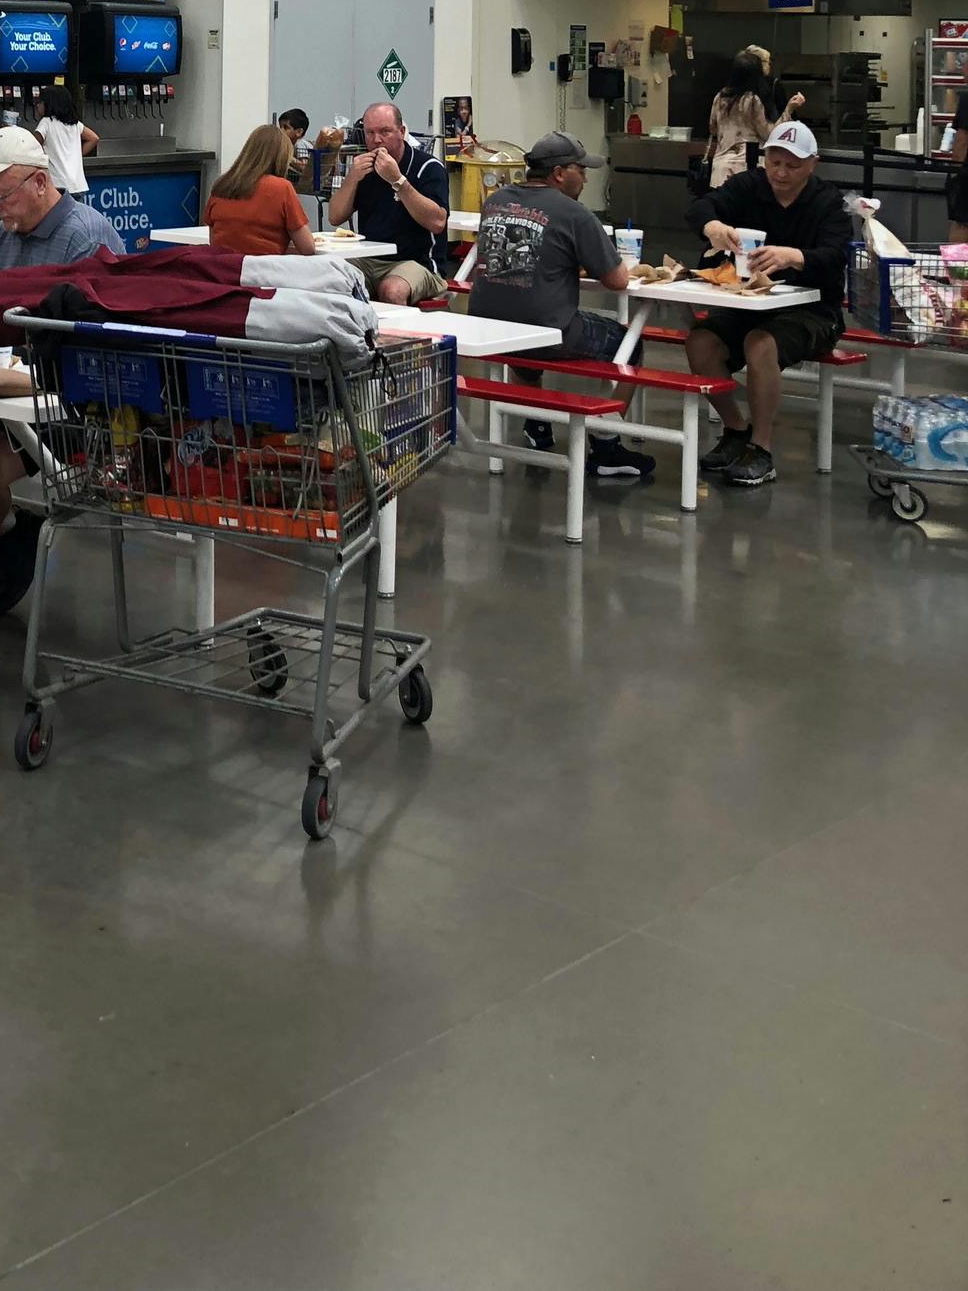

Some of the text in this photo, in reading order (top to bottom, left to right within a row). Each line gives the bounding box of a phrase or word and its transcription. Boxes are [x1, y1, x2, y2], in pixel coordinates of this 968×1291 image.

[14, 31, 53, 42] Your Club.
[9, 41, 57, 52] Your Choice.
[384, 69, 401, 83] 2187
[100, 186, 143, 209] Club.
[103, 210, 153, 231] hoice.
